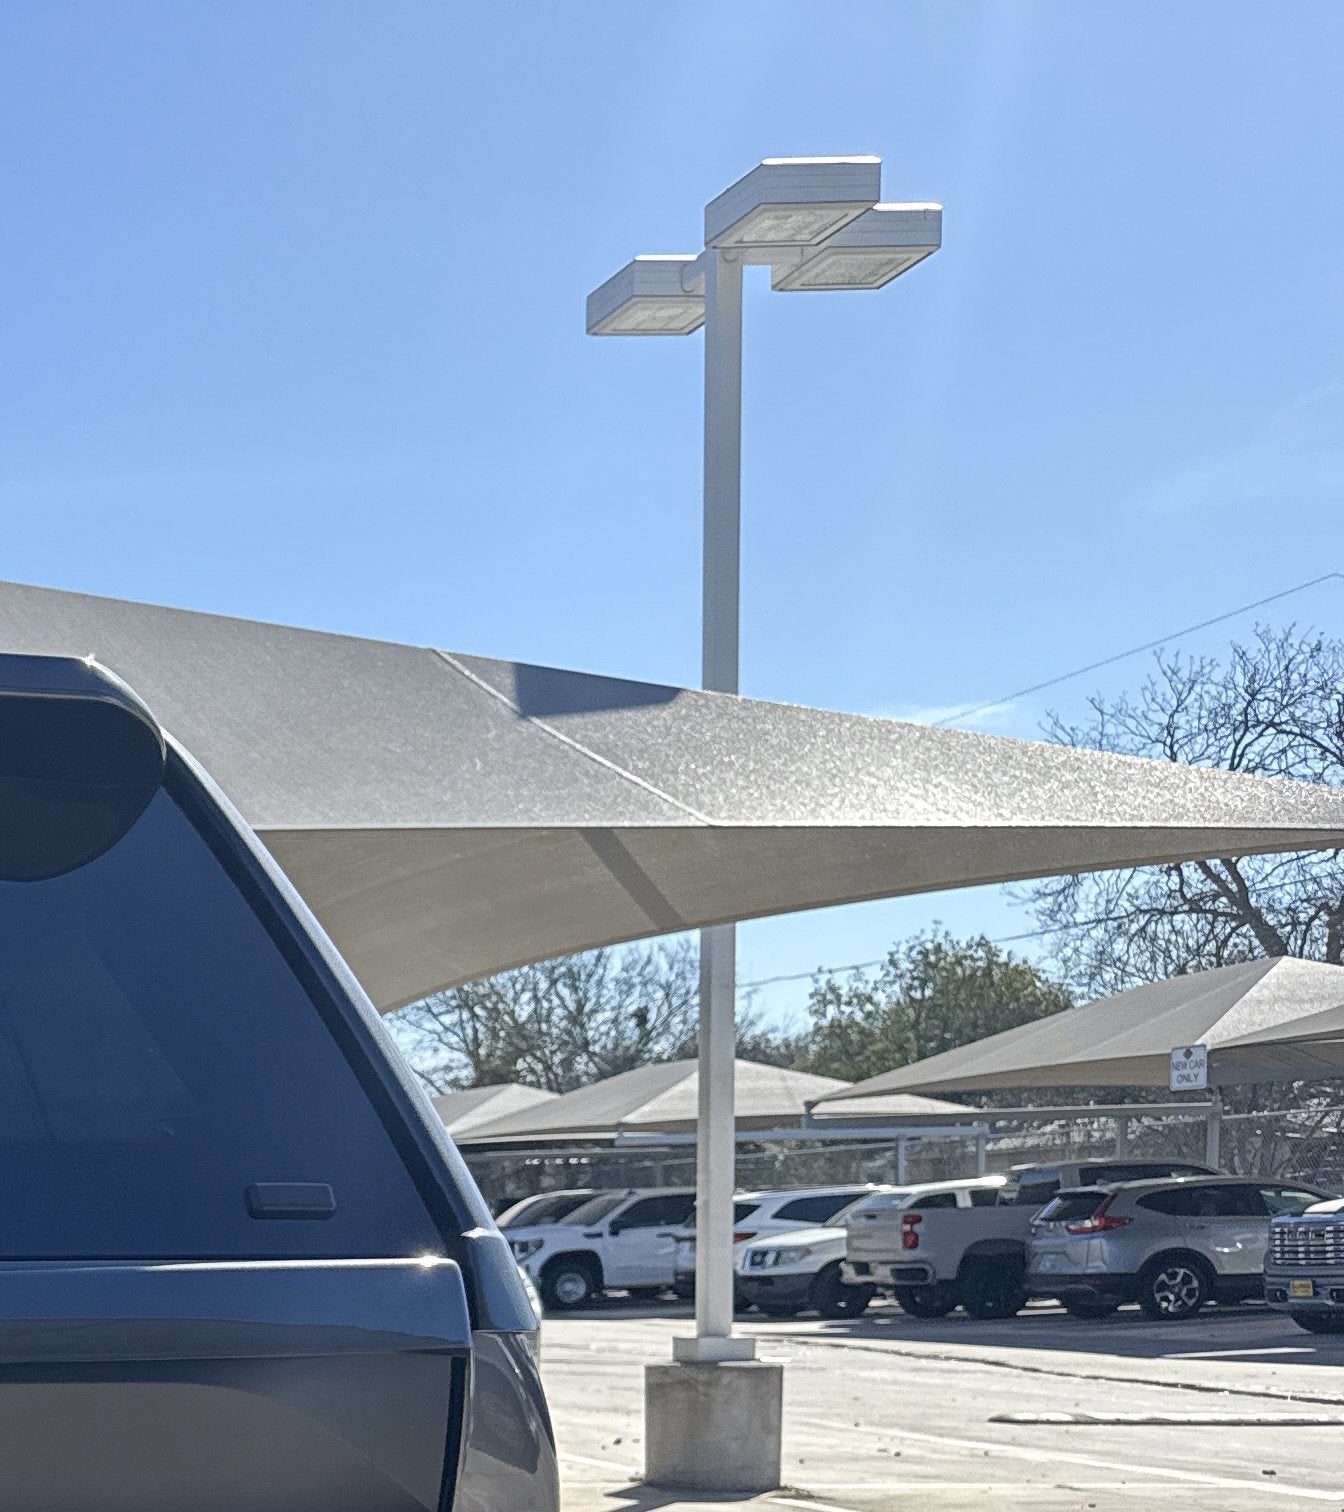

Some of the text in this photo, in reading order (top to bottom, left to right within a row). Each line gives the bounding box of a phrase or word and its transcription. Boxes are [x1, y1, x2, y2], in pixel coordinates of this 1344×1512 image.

[1172, 1058, 1205, 1071] NEW CAR
[1176, 1072, 1199, 1084] ONLY
